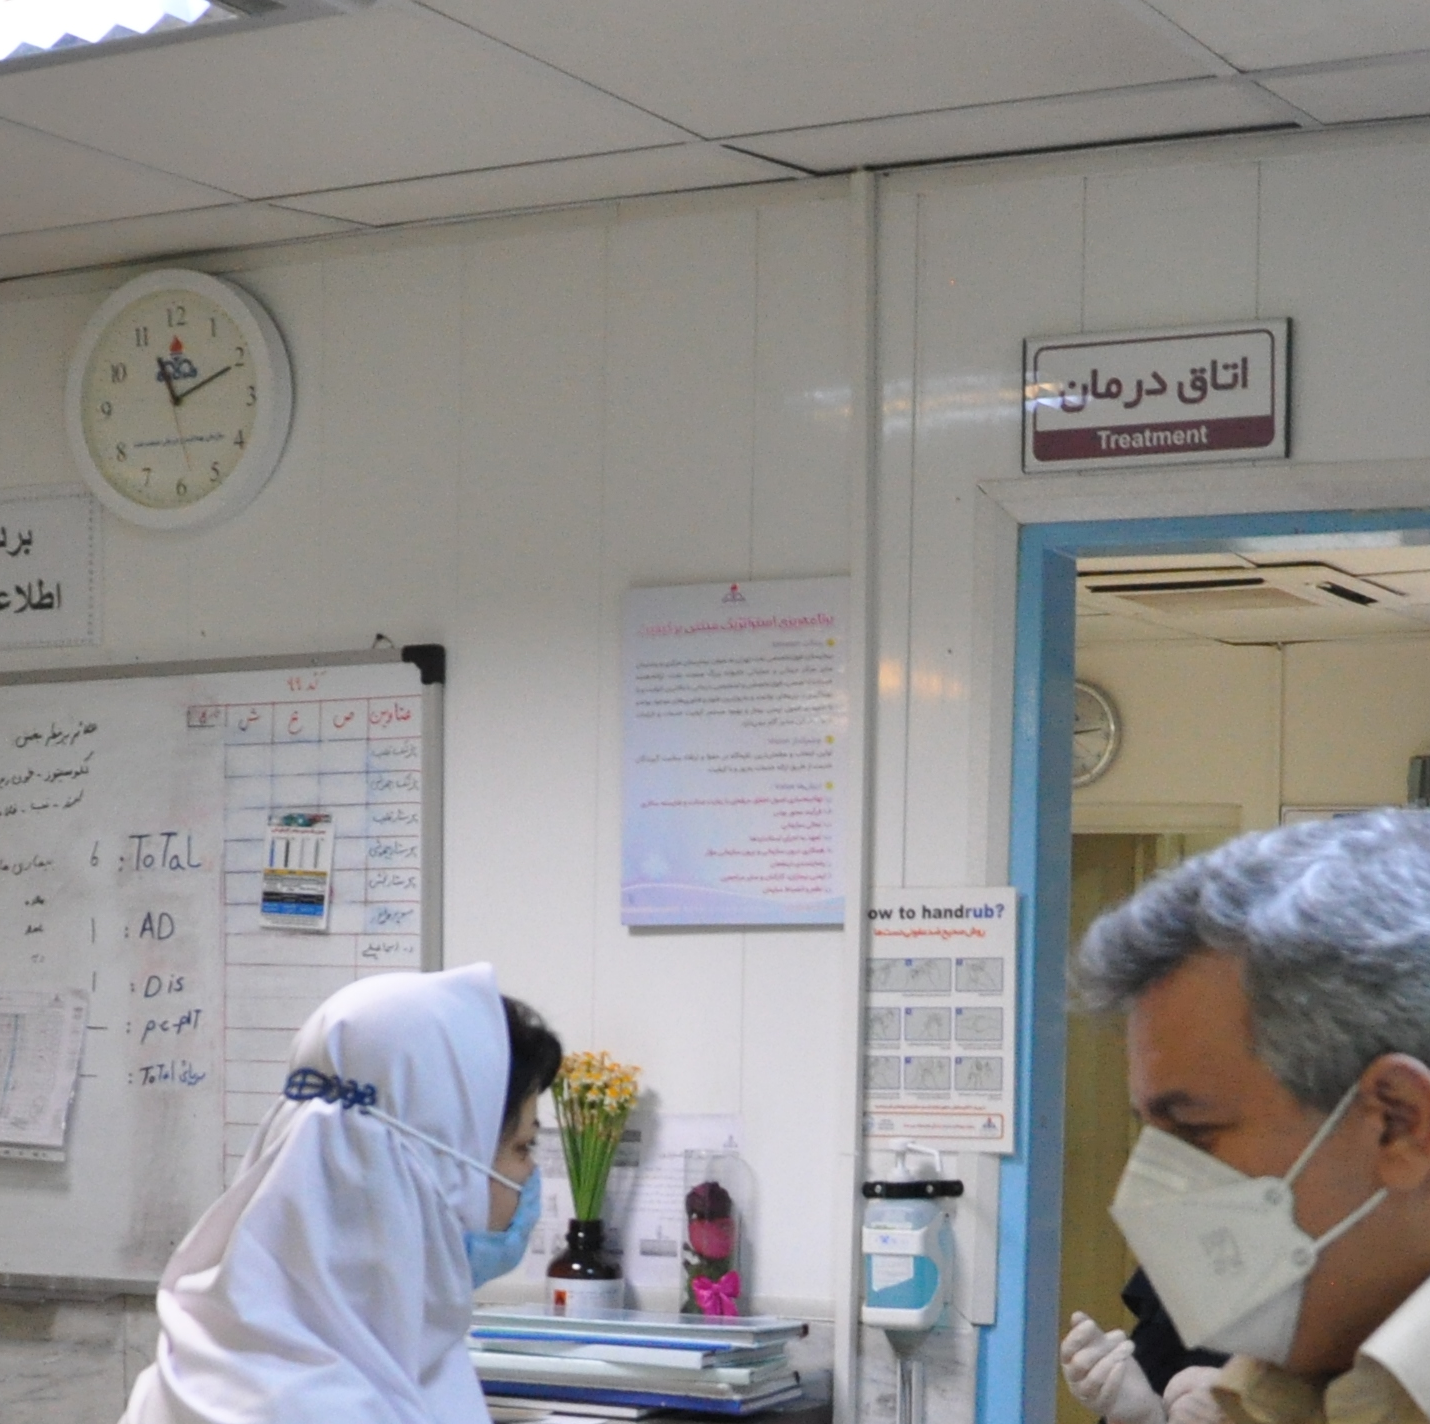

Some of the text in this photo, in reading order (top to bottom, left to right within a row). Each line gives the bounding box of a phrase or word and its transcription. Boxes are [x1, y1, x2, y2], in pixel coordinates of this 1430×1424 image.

[167, 306, 186, 327] 12
[135, 327, 148, 347] 11
[209, 317, 216, 338] 1
[235, 346, 245, 367] 2
[111, 362, 127, 383] 10
[246, 385, 256, 406] 3
[1059, 356, 1249, 414] اتاق درمان
[101, 401, 112, 419] 9
[233, 429, 244, 450] 4
[1097, 425, 1208, 450] Treatment
[116, 441, 127, 462] 8
[142, 467, 152, 487] 7
[210, 461, 220, 482] 5
[176, 477, 187, 497] 6
[867, 903, 1005, 920] ow to handrub?
[139, 911, 175, 941] AD
